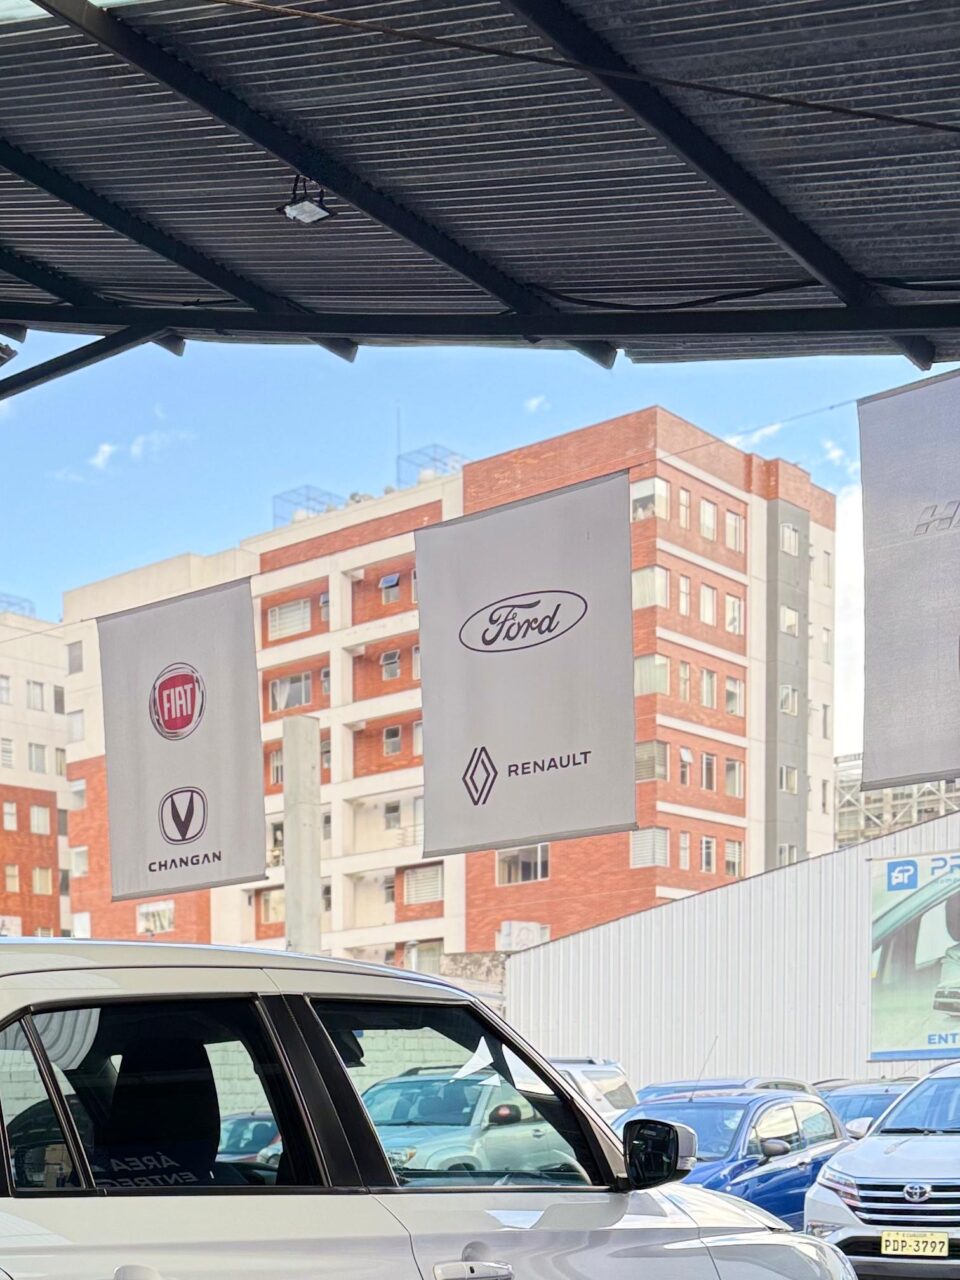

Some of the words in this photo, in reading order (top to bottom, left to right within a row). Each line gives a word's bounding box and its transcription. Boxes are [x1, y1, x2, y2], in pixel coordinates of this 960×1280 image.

[481, 599, 562, 646] Ford
[162, 684, 194, 721] FIAT
[507, 750, 592, 777] RENAULT
[148, 850, 222, 873] CHANGAN
[884, 1239, 946, 1253] PDP-3797
